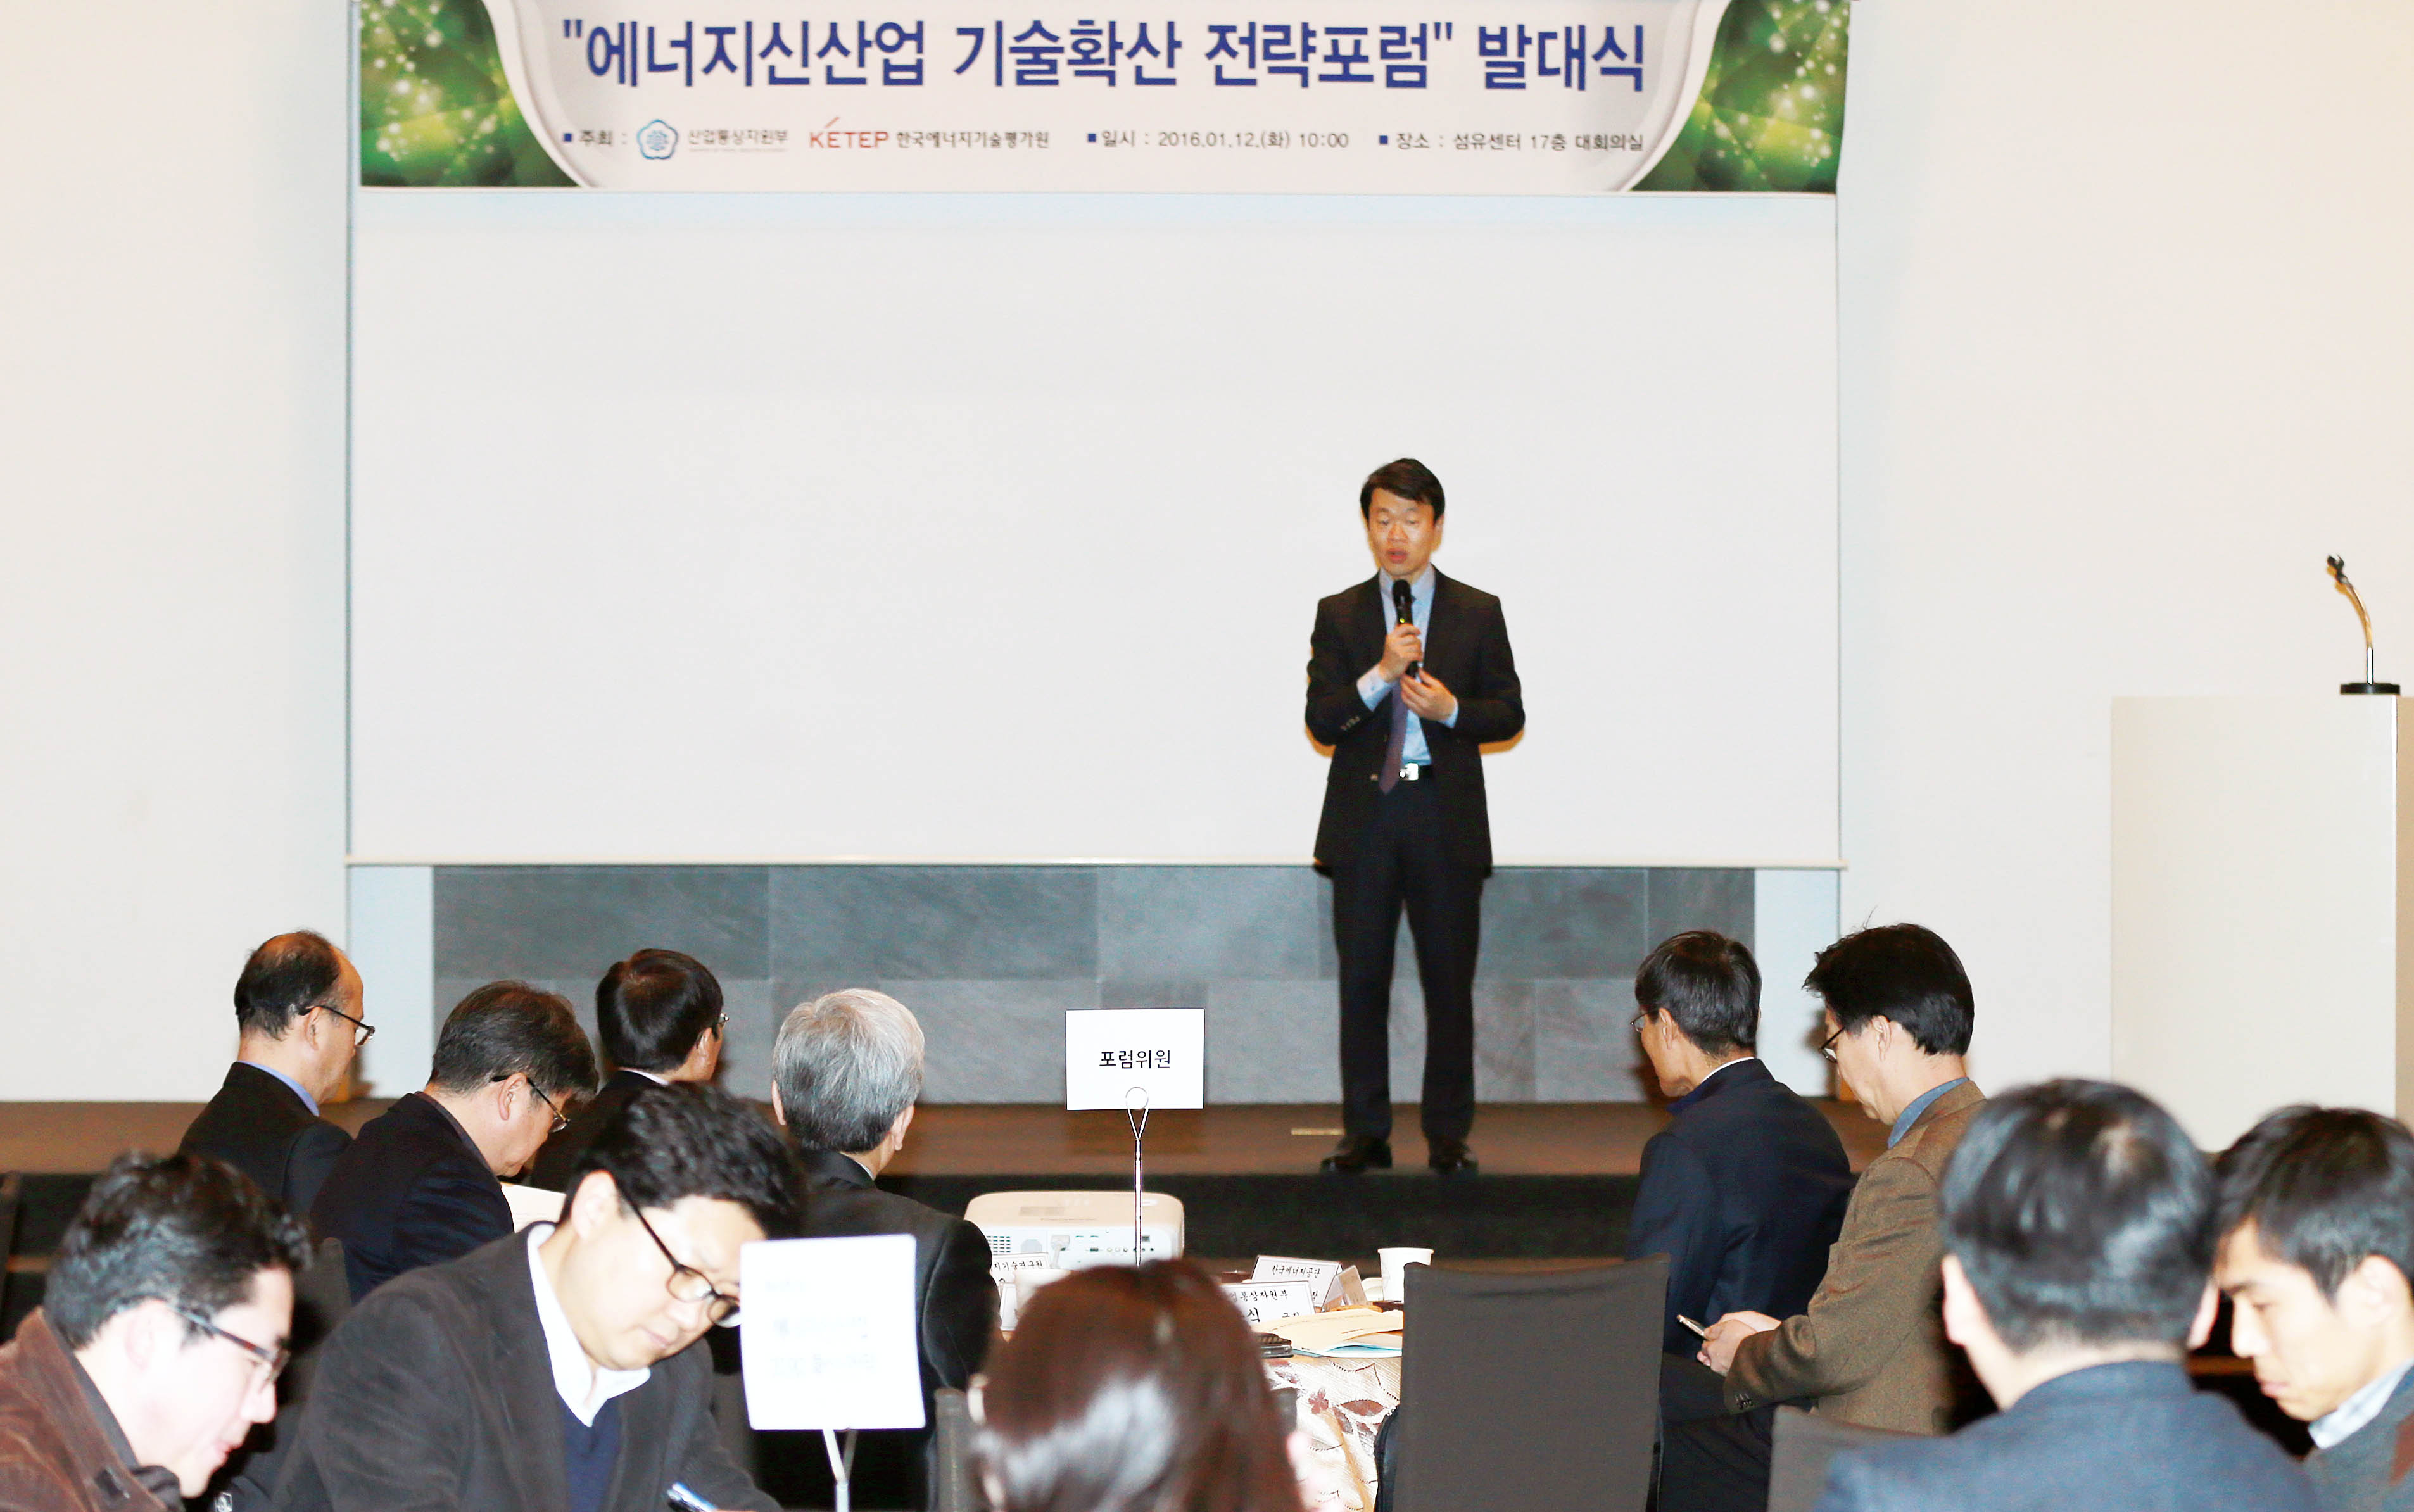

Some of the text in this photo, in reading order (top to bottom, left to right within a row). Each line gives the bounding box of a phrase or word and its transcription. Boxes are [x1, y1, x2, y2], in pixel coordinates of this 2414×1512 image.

[563, 18, 1644, 92] "에너지신산업 기술확산 전략포럼" 발대식
[579, 129, 613, 147] 주최
[896, 130, 1049, 149] 한국에너지기술평가원
[1101, 130, 1135, 148] 일시
[1299, 132, 1349, 148] 10:00
[1396, 132, 1430, 150] 장소
[1454, 133, 1521, 151] 섬유센터
[1531, 134, 1567, 151] 17층
[1575, 134, 1645, 152] 대회의실
[1099, 1049, 1170, 1069] 포럼위원
